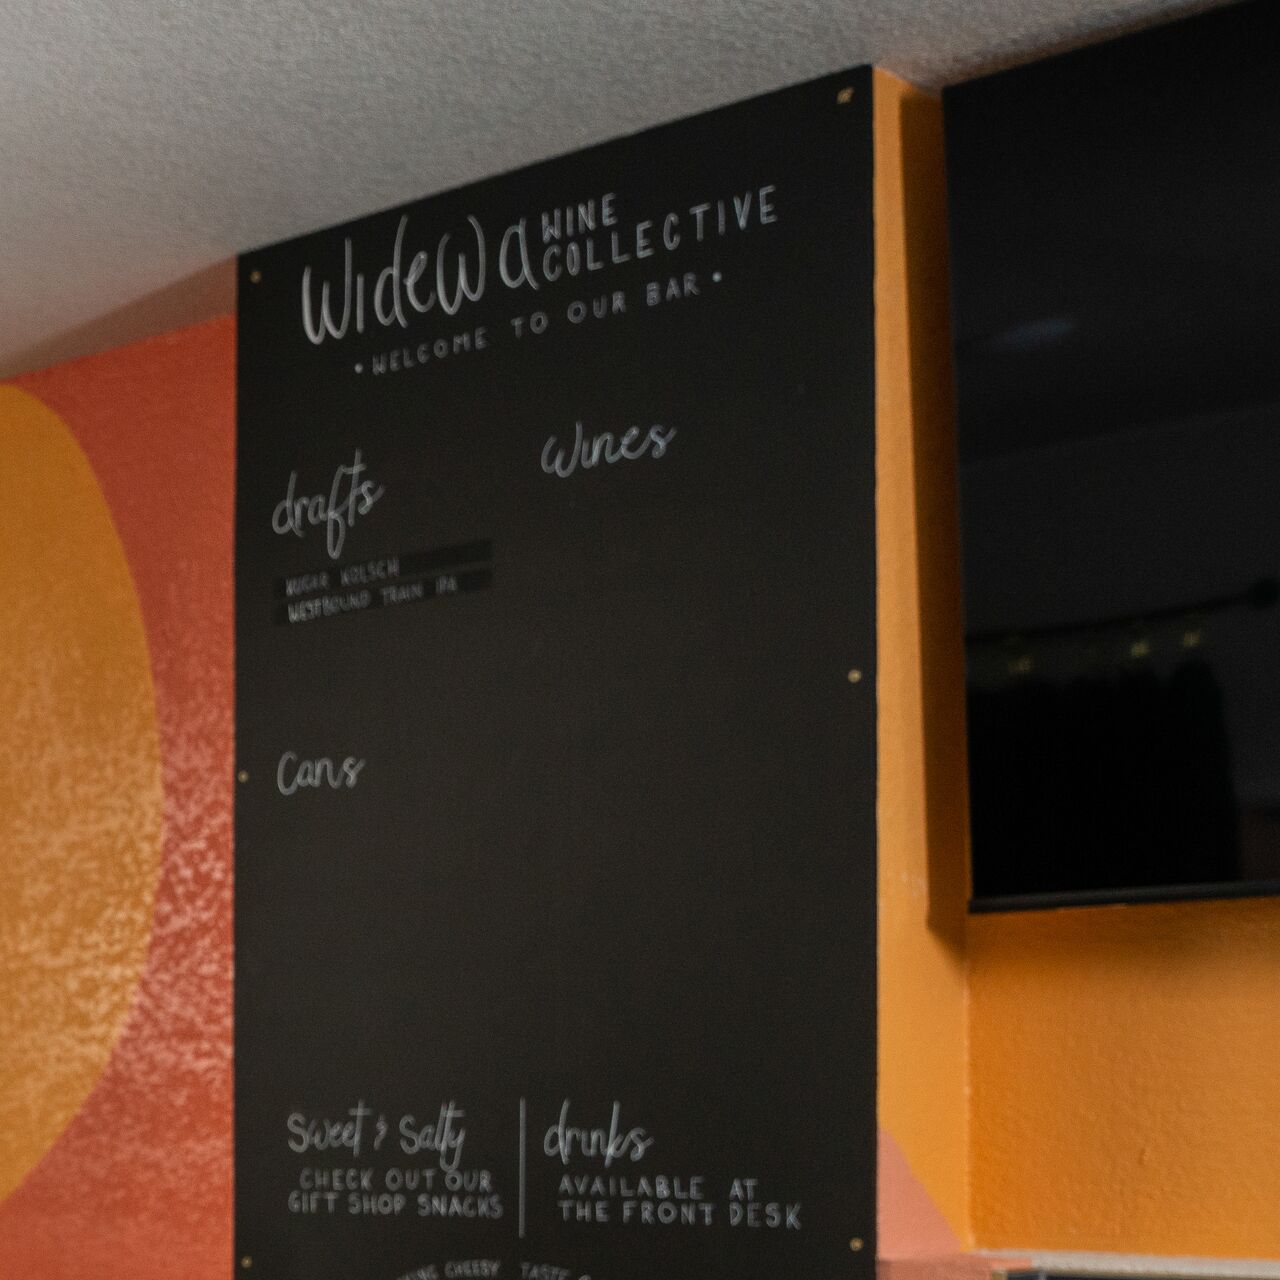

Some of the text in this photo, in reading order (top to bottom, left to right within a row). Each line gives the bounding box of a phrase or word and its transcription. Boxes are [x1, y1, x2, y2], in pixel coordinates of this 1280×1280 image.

[542, 192, 618, 243] WINE
[542, 185, 778, 281] COLLECTIVE
[372, 274, 701, 375] WELCOME TO OUR BAR
[272, 448, 384, 559] drafts
[287, 1099, 374, 1156] Sweet
[399, 1099, 466, 1173] Salty
[544, 1099, 654, 1167] drinks
[287, 1189, 504, 1220] GIFT SHOP SNACKS
[299, 1167, 493, 1193] CHECK OUT OUR
[559, 1176, 760, 1200] AVAILABLE AT
[559, 1200, 803, 1230] THE FRONT DESK
[444, 1258, 502, 1279] CHEESY
